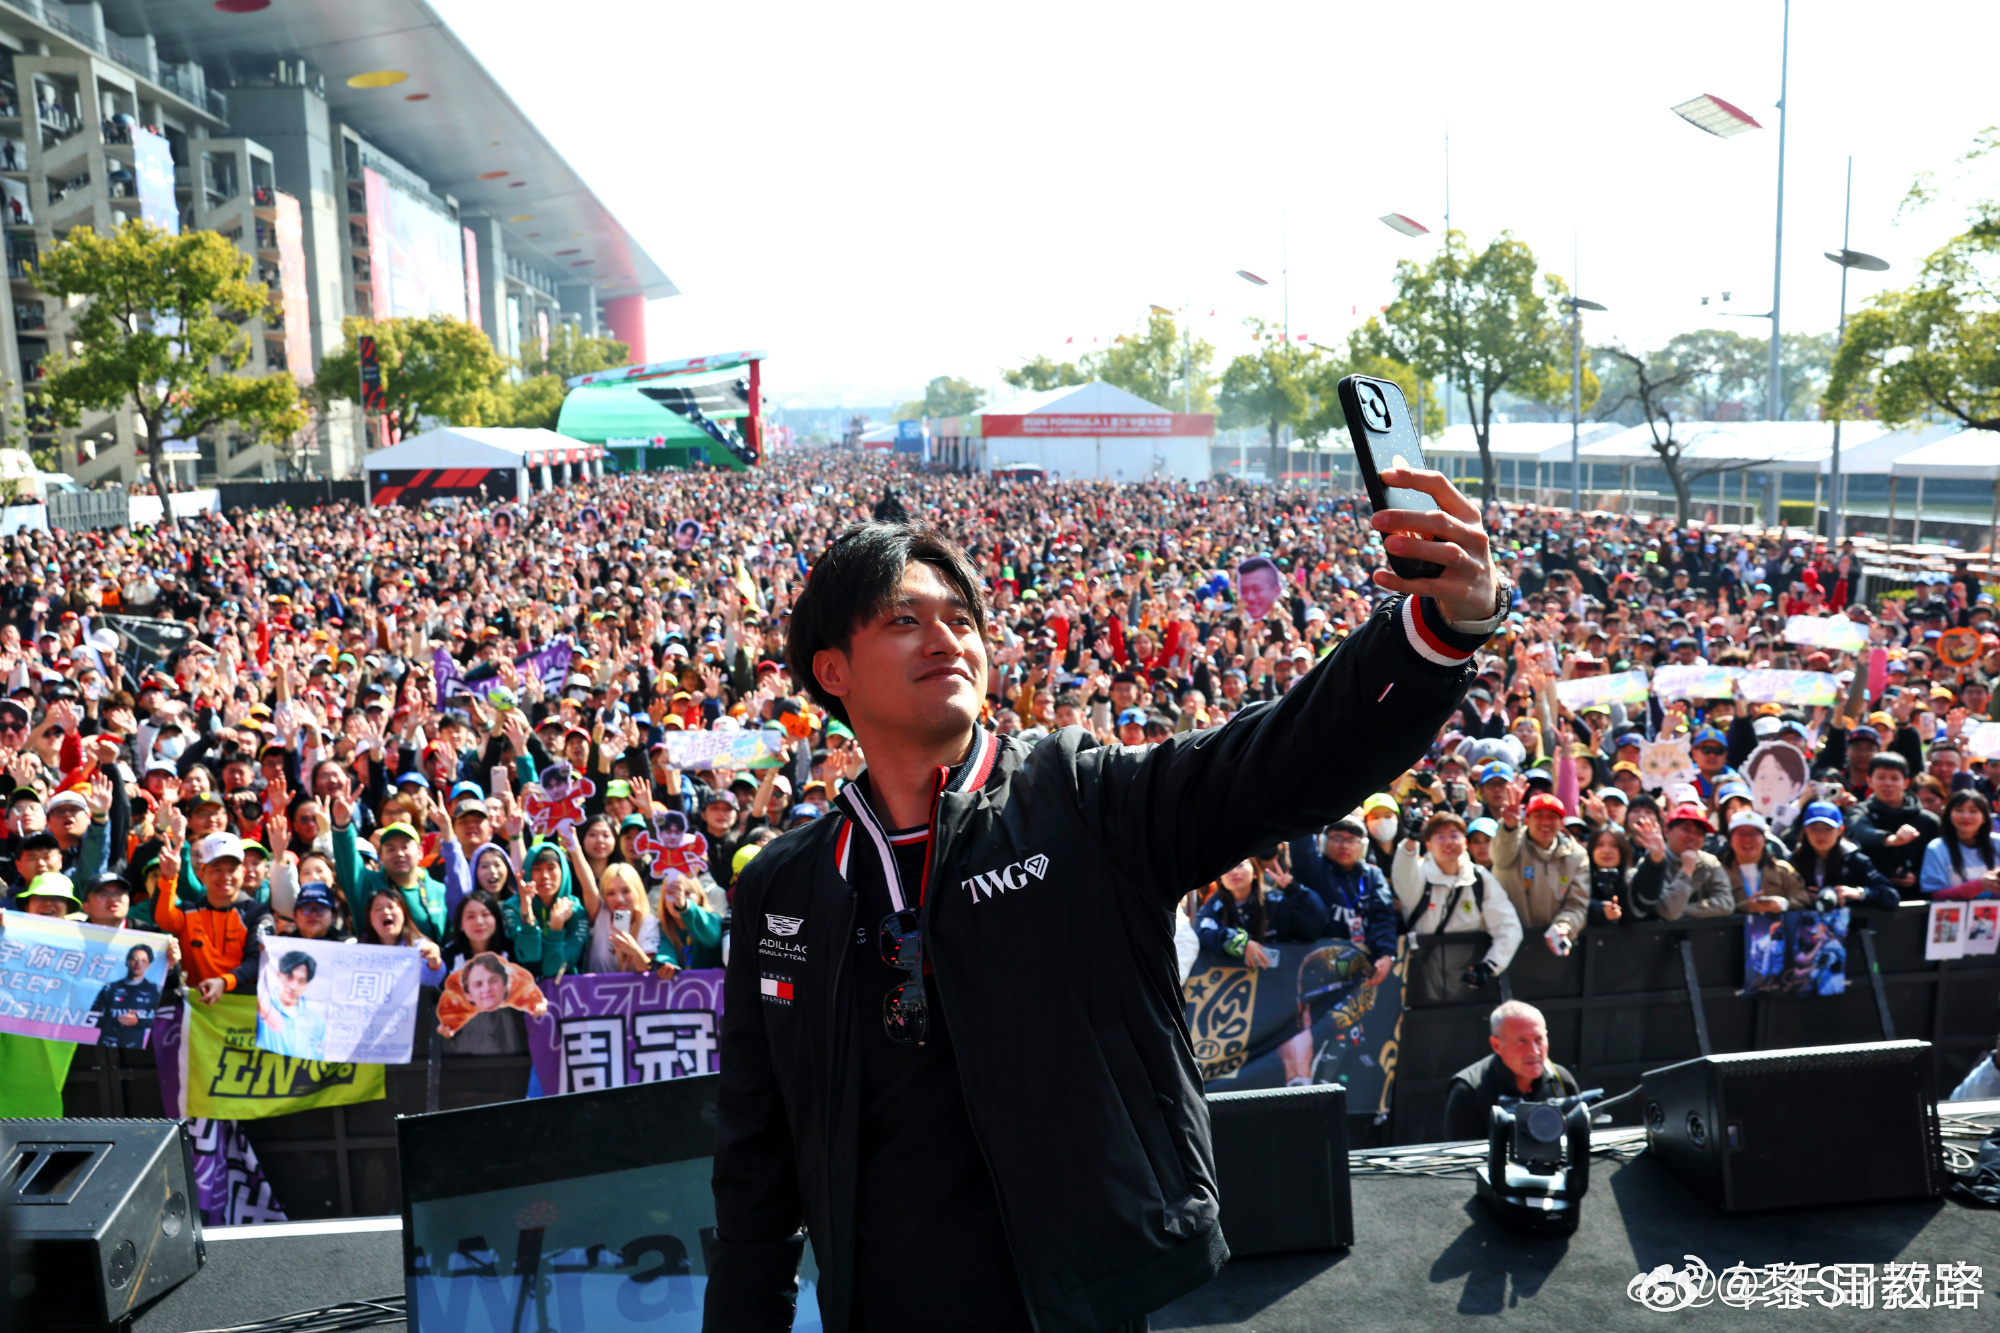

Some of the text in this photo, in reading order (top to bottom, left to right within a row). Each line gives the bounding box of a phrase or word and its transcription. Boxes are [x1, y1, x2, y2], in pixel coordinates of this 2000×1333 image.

[961, 861, 1029, 905] TWG
[759, 938, 808, 955] ADILLAC
[0, 997, 104, 1028] USHING
[594, 978, 725, 1040] ZHO
[414, 1226, 717, 1333] Wra
